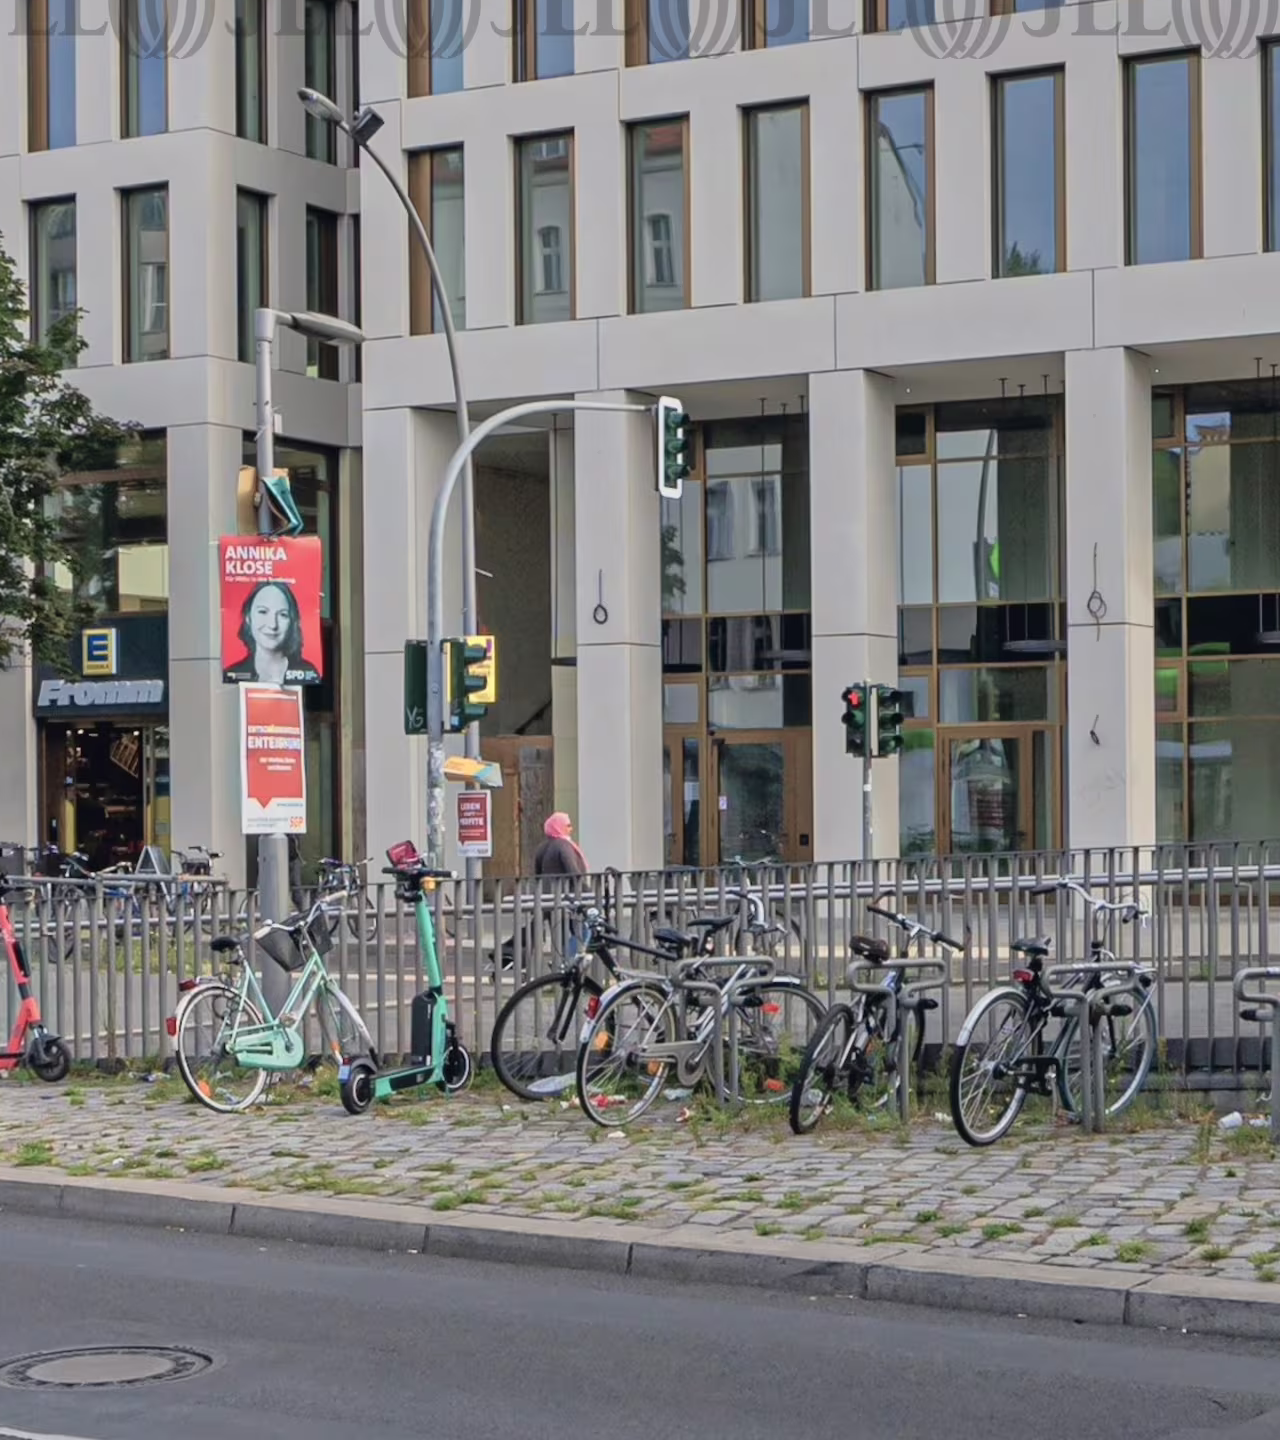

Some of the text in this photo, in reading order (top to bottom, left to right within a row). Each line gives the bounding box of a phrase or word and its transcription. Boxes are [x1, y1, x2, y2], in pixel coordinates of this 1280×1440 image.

[224, 545, 287, 561] ANNIKA
[225, 560, 273, 575] KLOSE
[285, 670, 305, 681] SPD
[37, 678, 165, 707] Fromm
